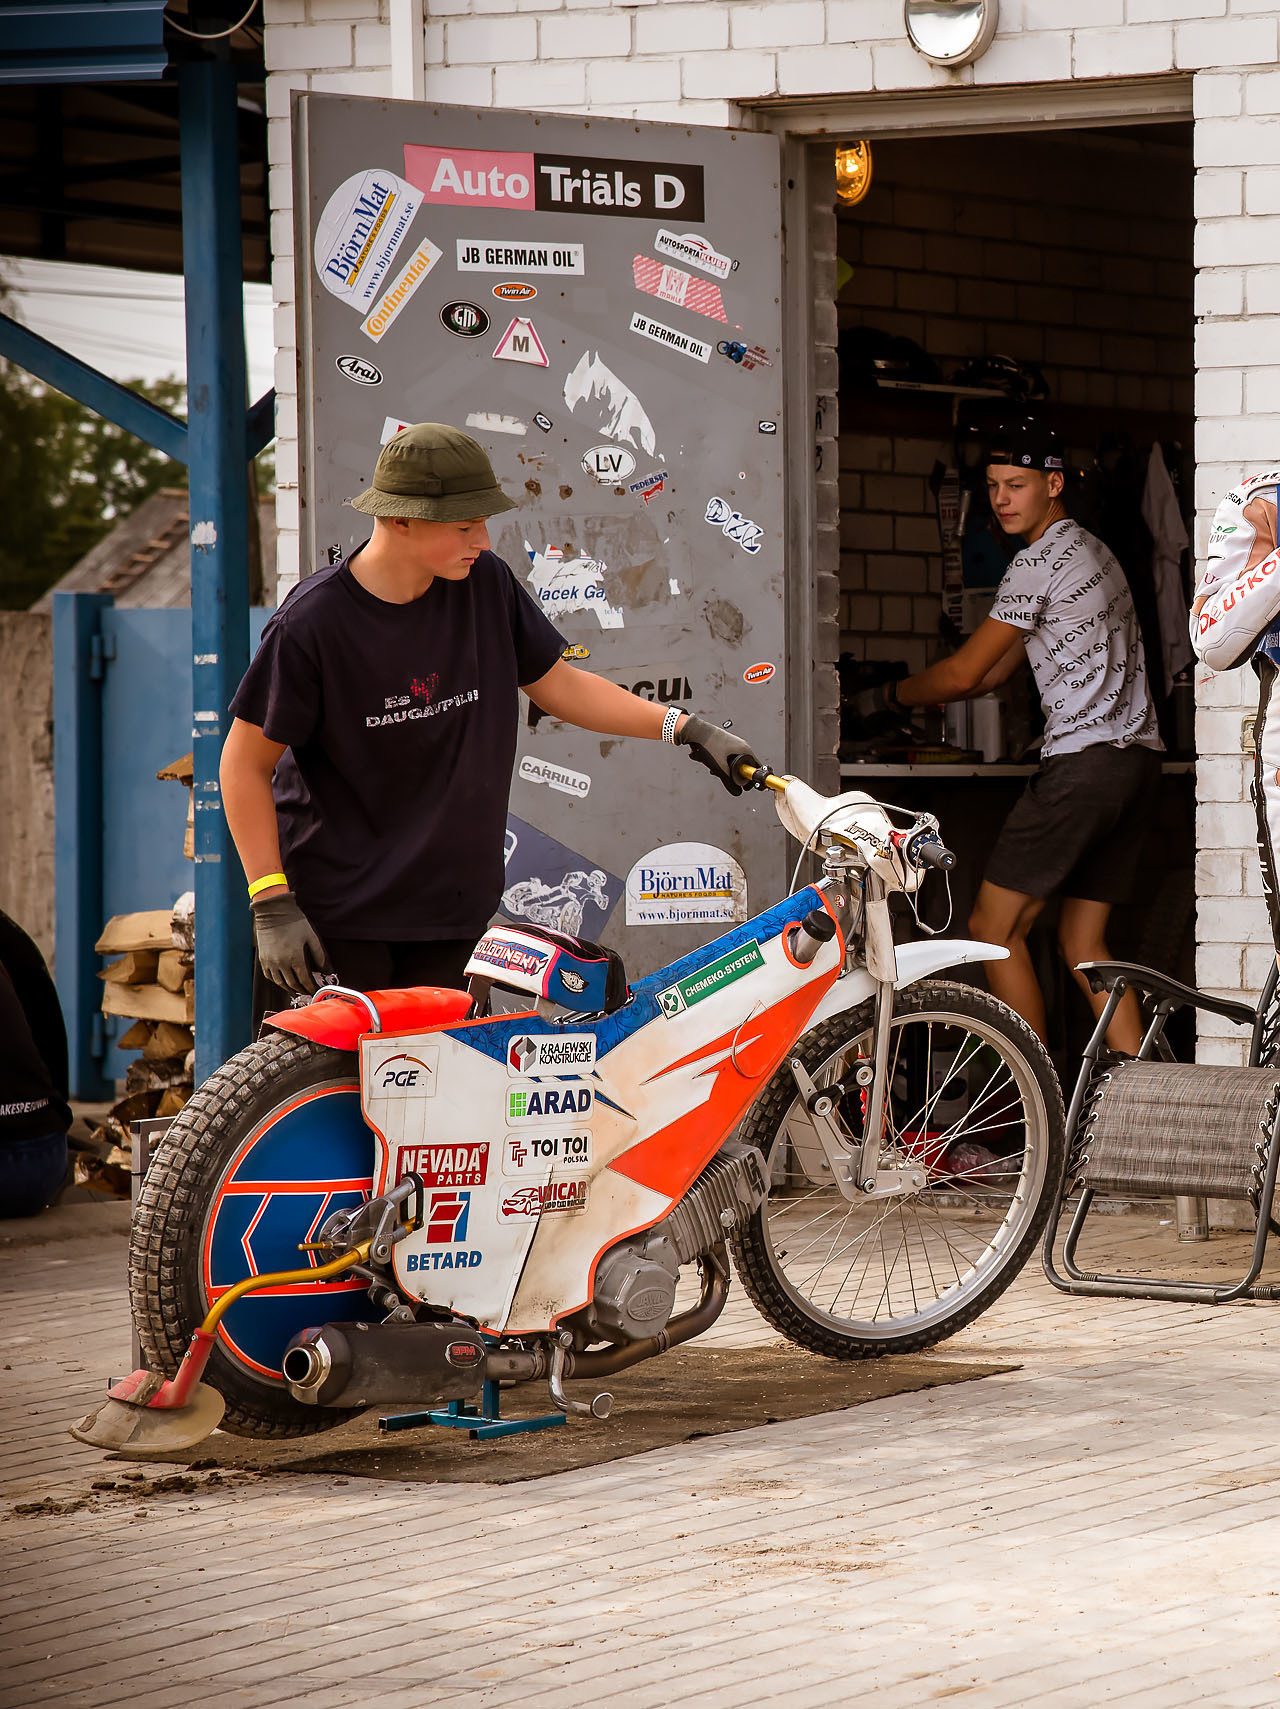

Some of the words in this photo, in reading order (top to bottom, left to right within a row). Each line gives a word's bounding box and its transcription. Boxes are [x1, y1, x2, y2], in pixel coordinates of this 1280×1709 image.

[430, 158, 530, 199] Auto
[540, 165, 642, 207] Triāls
[654, 174, 686, 209] D
[325, 181, 390, 284] BjörnMat
[363, 202, 414, 299] www.bjornmat.se
[462, 247, 480, 264] JB
[485, 248, 548, 266] GERMAN
[366, 251, 431, 336] Continental
[500, 287, 519, 295] Twin
[519, 287, 532, 295] Air
[453, 308, 477, 328] GM
[512, 335, 530, 353] M
[634, 318, 647, 331] JB
[648, 323, 689, 350] GERMAN
[689, 342, 704, 357] OIL
[340, 359, 377, 381] Arai
[595, 454, 622, 473] LV
[630, 470, 669, 493] PEDERSEN
[745, 669, 761, 681] Twin
[760, 666, 773, 677] Air
[521, 761, 589, 791] CARRILLO
[638, 866, 734, 899] BjörnMat
[638, 908, 735, 923] www.bjornmat.se
[539, 1052, 592, 1065] KONSTRUKCJE
[540, 1041, 592, 1055] KRAJEWSKI
[382, 1070, 418, 1088] PGE
[526, 1088, 592, 1116] ARAD
[532, 1138, 558, 1157] TOI
[562, 1136, 588, 1156] TOI
[563, 1156, 588, 1164] POLSKA
[437, 1173, 482, 1185] PARTS
[538, 1181, 587, 1203] WICAR
[406, 1250, 483, 1272] BETARD
